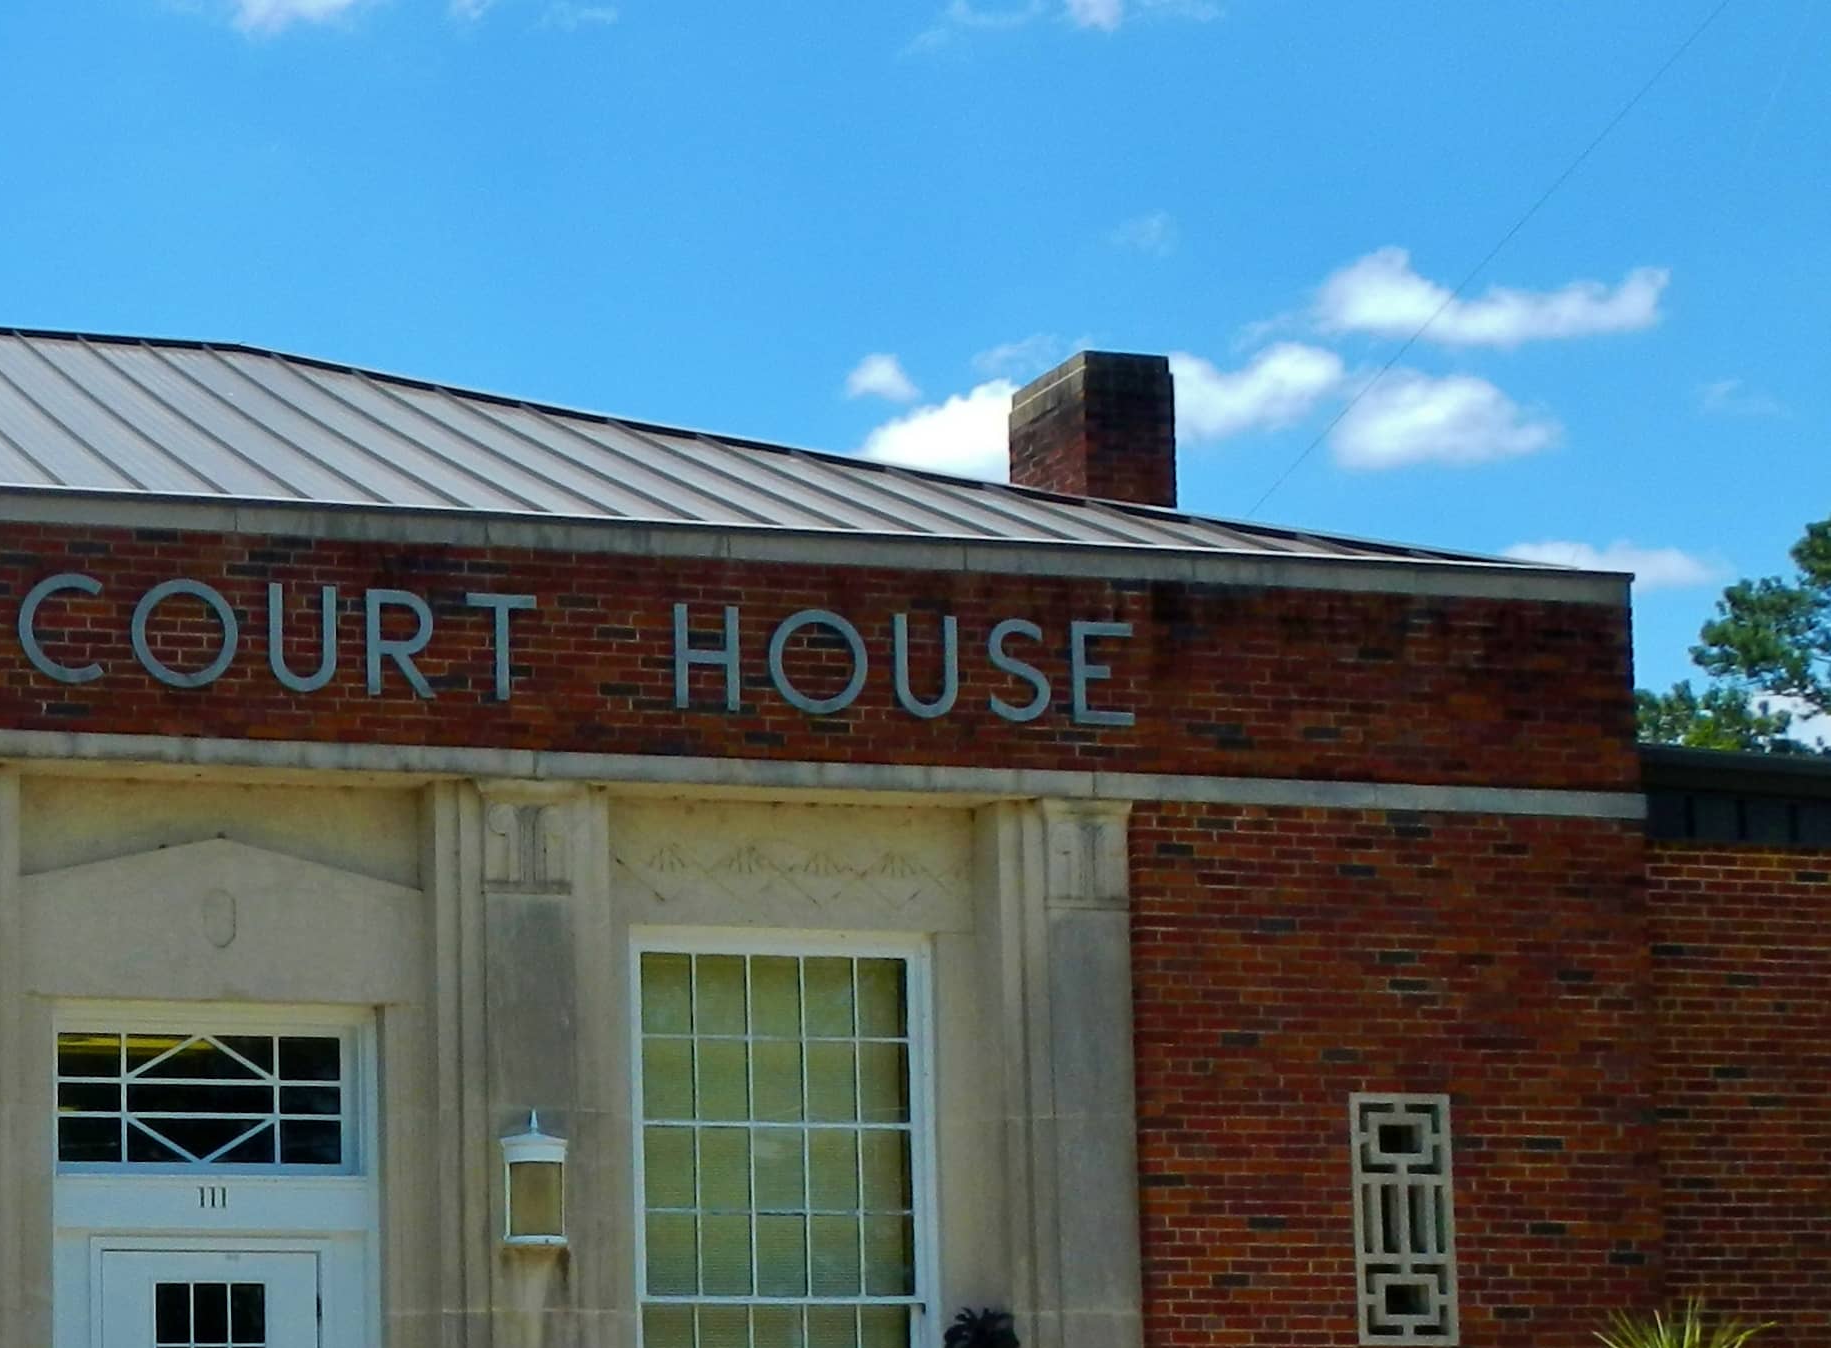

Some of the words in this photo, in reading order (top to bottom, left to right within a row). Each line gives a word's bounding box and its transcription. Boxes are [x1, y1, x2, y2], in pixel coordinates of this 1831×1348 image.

[18, 573, 537, 703] COURT
[672, 602, 1135, 726] HOUSE
[197, 1186, 227, 1209] 111
